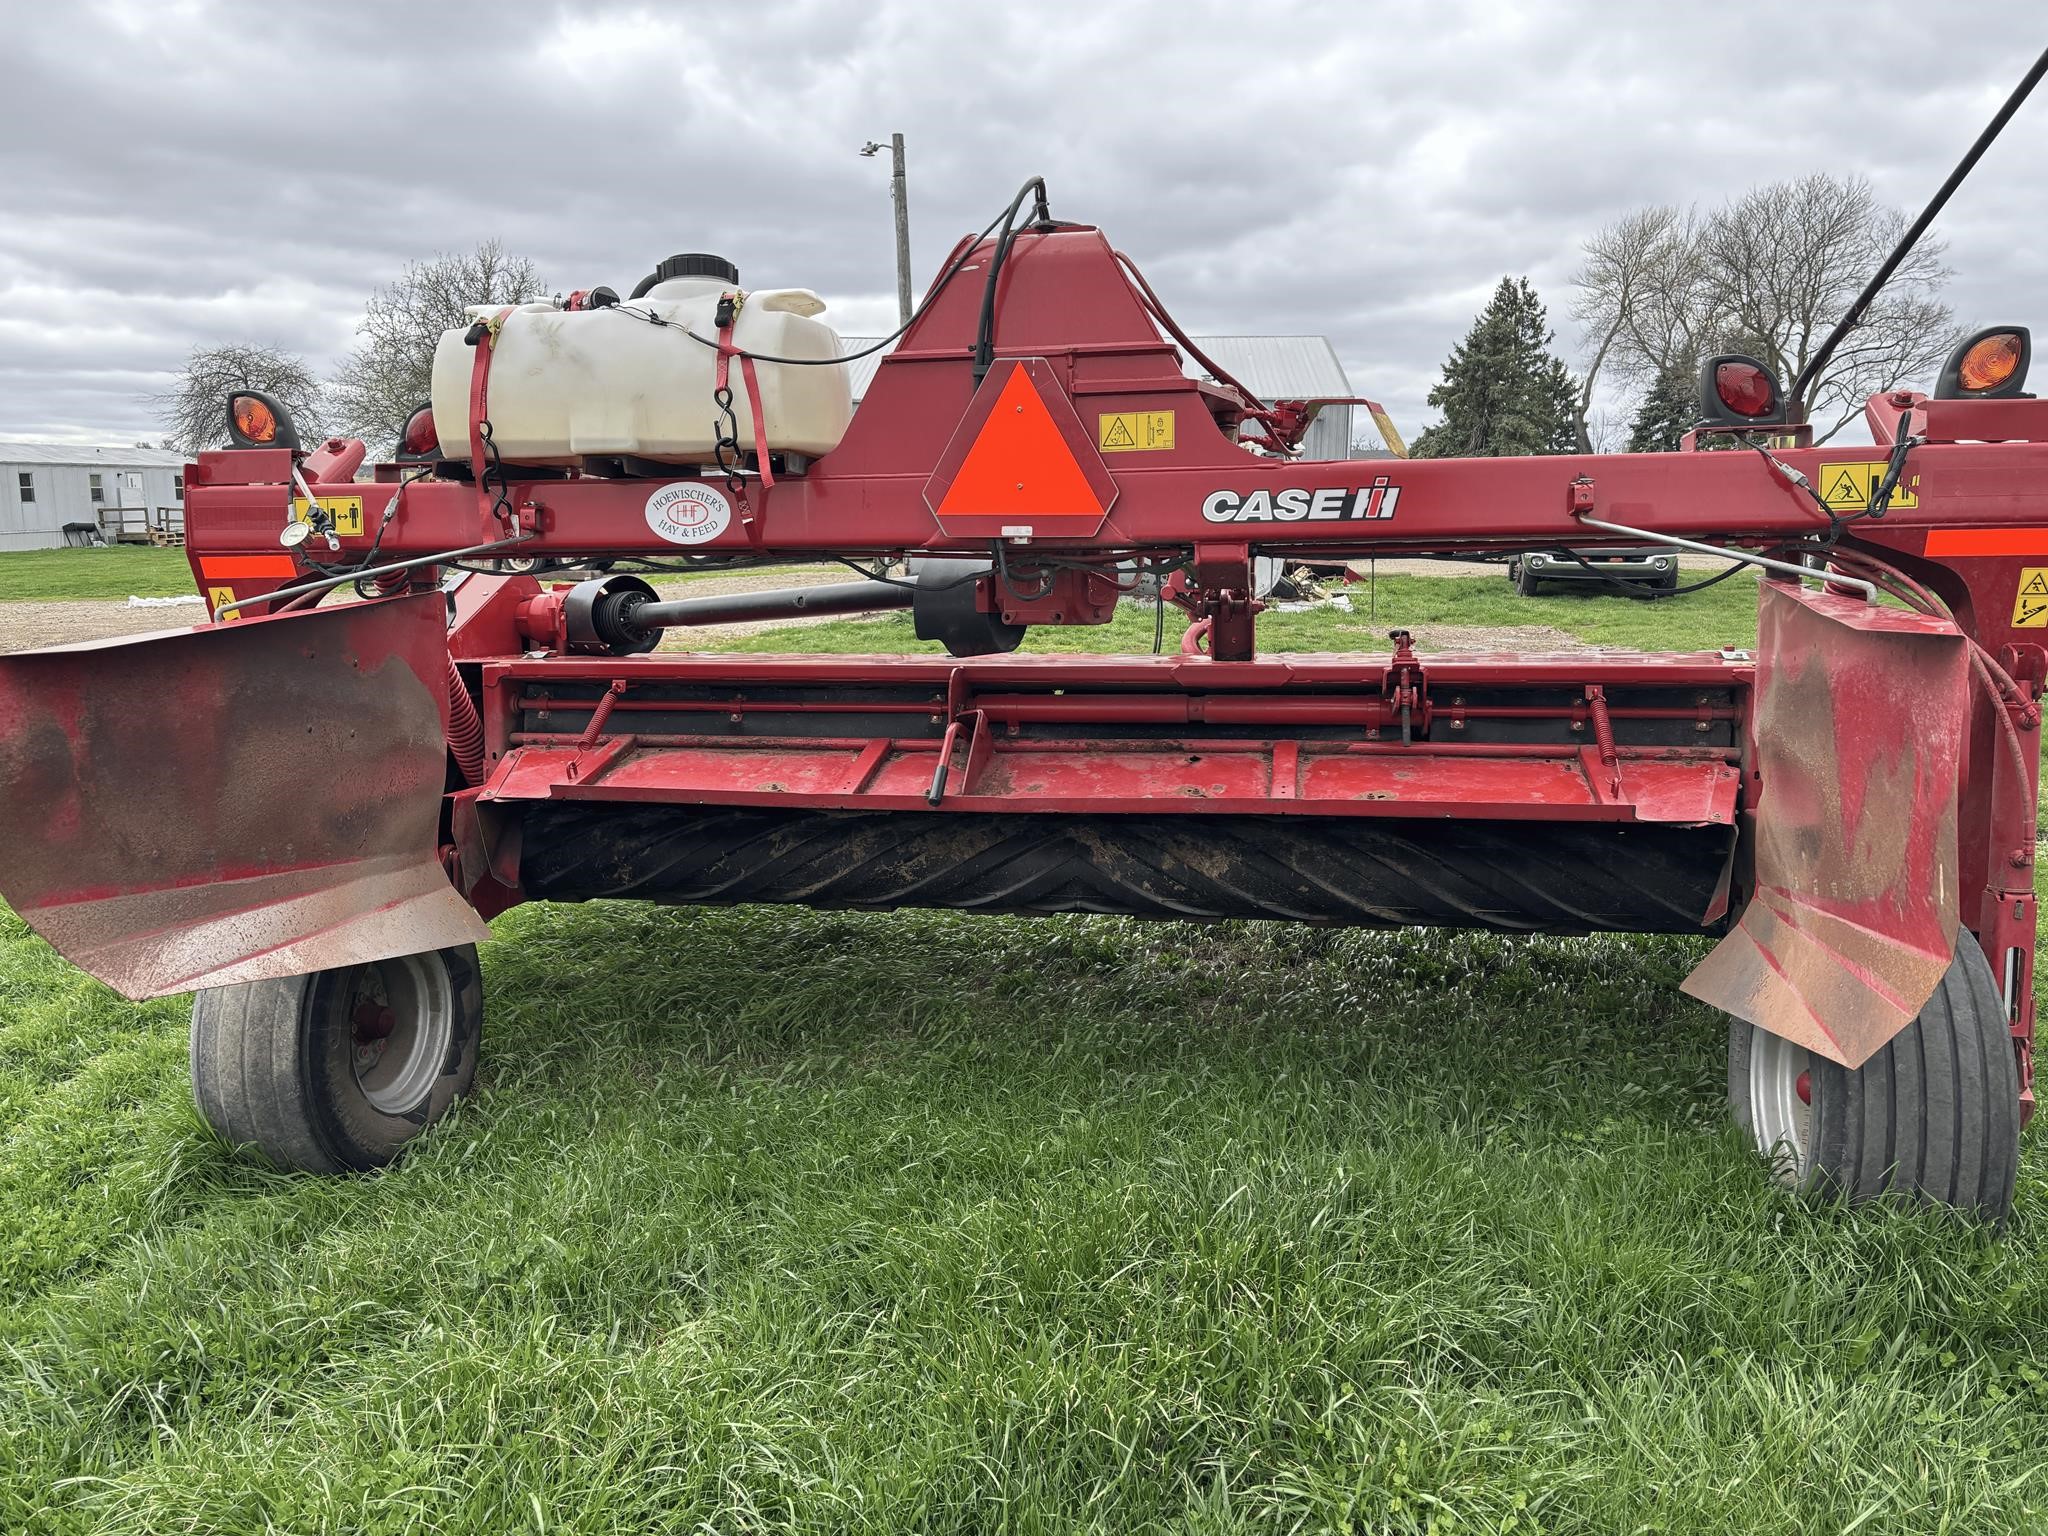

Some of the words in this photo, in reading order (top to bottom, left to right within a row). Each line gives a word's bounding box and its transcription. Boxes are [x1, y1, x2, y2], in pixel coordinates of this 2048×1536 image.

[652, 489, 724, 512] HOEWISCHER'S
[1202, 488, 1348, 522] CASE
[658, 519, 679, 535] HAY
[681, 527, 690, 537] &
[692, 520, 718, 537] FEED
